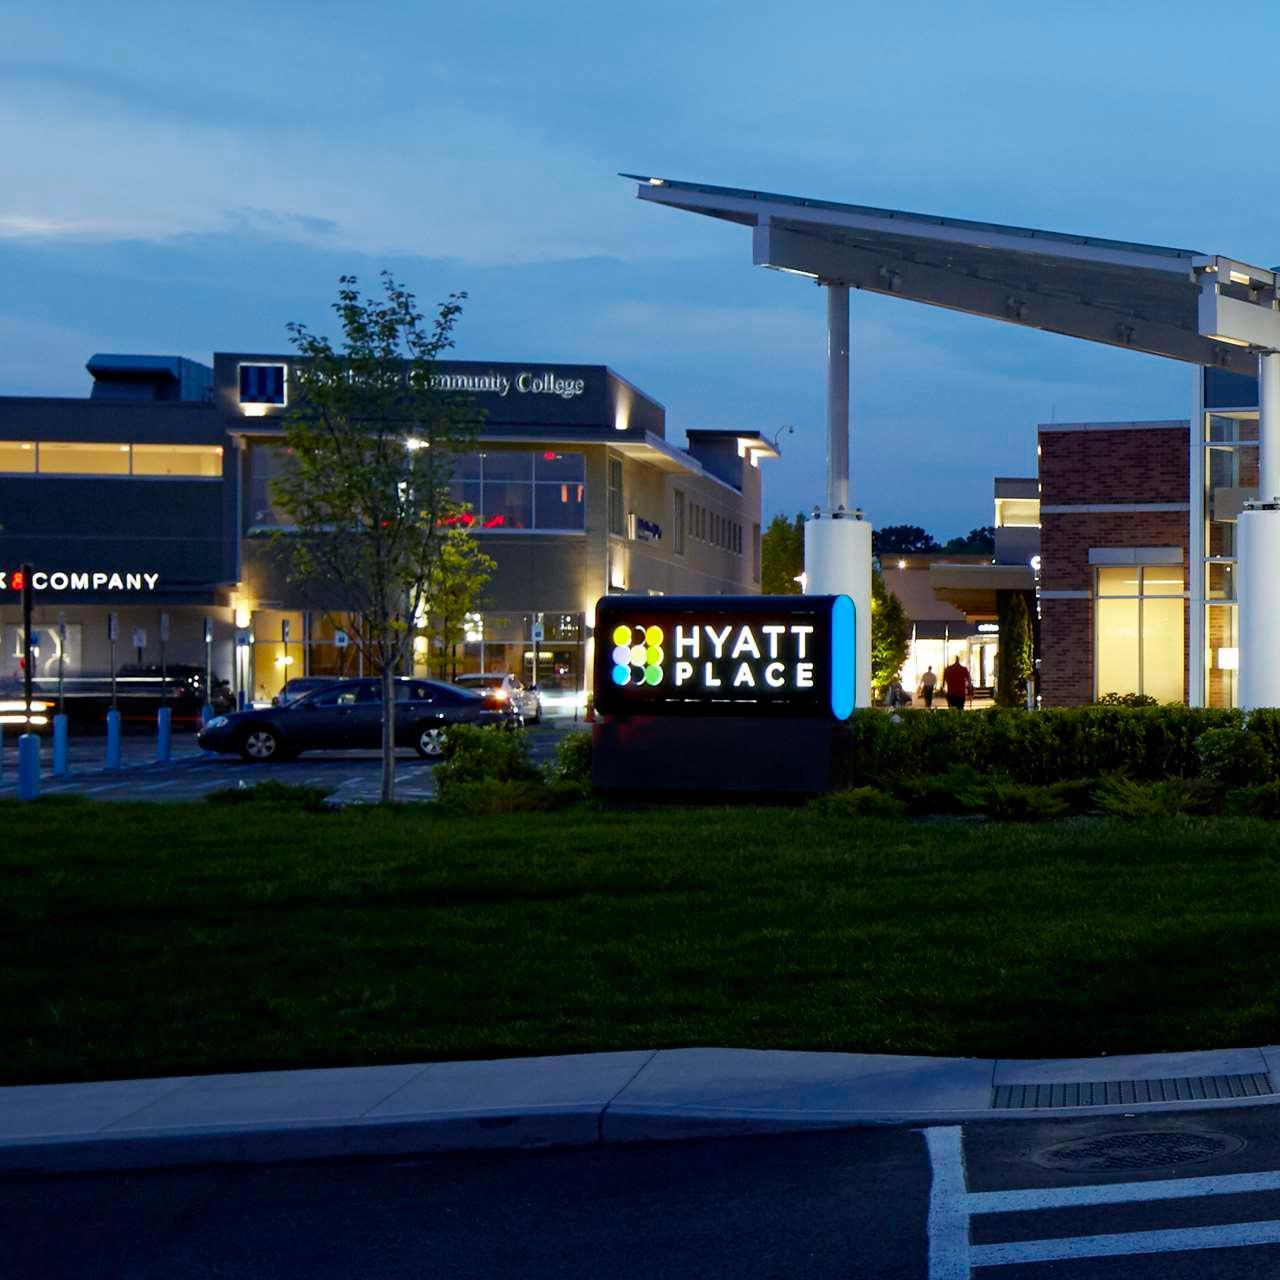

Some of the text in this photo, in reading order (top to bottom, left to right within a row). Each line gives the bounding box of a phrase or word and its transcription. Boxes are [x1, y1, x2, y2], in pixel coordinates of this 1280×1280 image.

[516, 371, 585, 398] College
[32, 572, 159, 590] COMPANY
[674, 625, 815, 659] HYATT
[675, 662, 814, 688] PLACE
